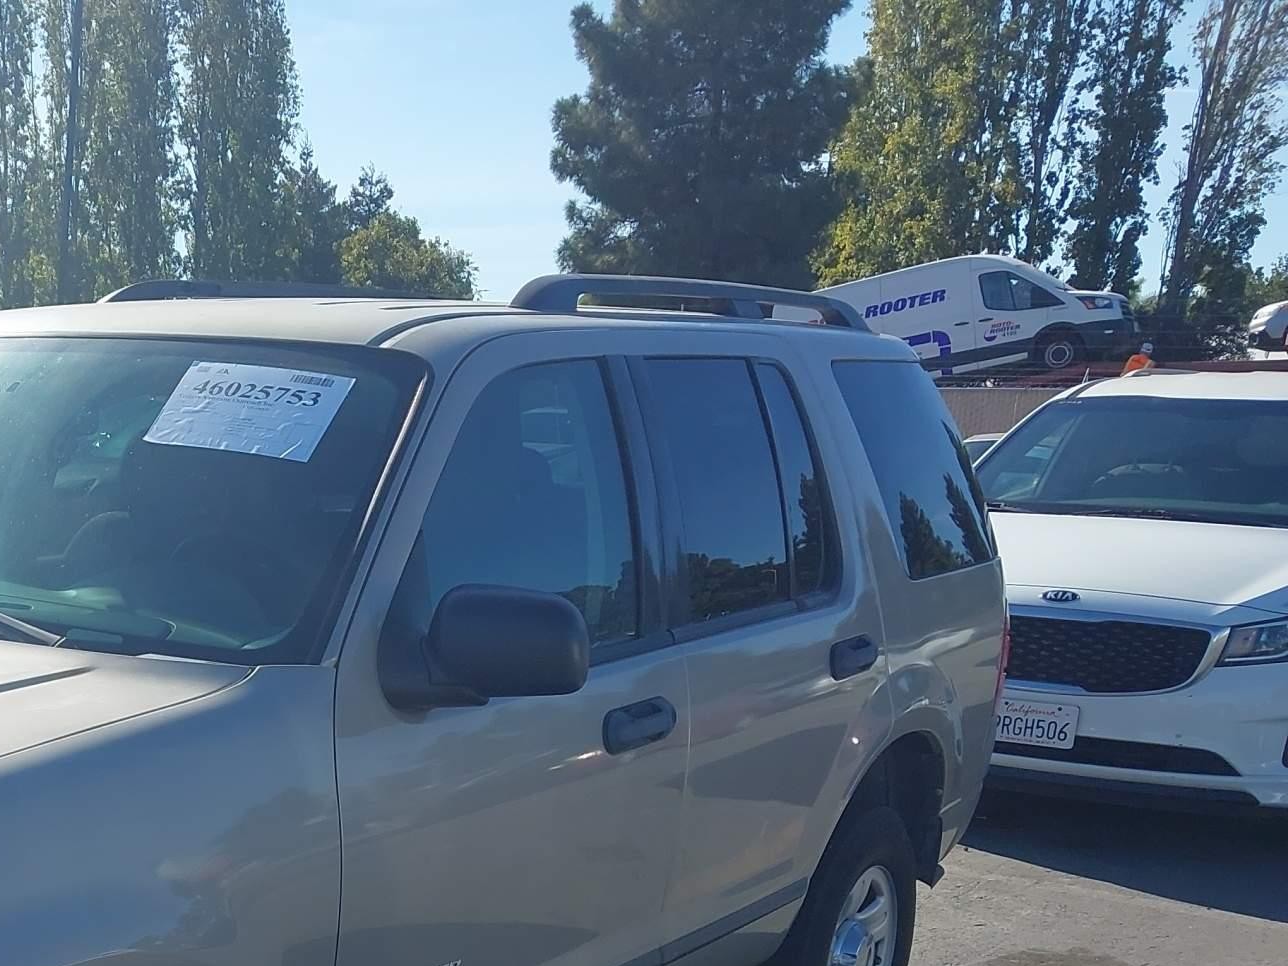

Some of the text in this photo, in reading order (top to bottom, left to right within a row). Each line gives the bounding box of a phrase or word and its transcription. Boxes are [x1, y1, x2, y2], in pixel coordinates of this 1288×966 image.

[865, 289, 946, 319] ROOTER
[193, 379, 322, 407] 46025753
[1046, 591, 1073, 600] KIA
[1006, 703, 1059, 716] California
